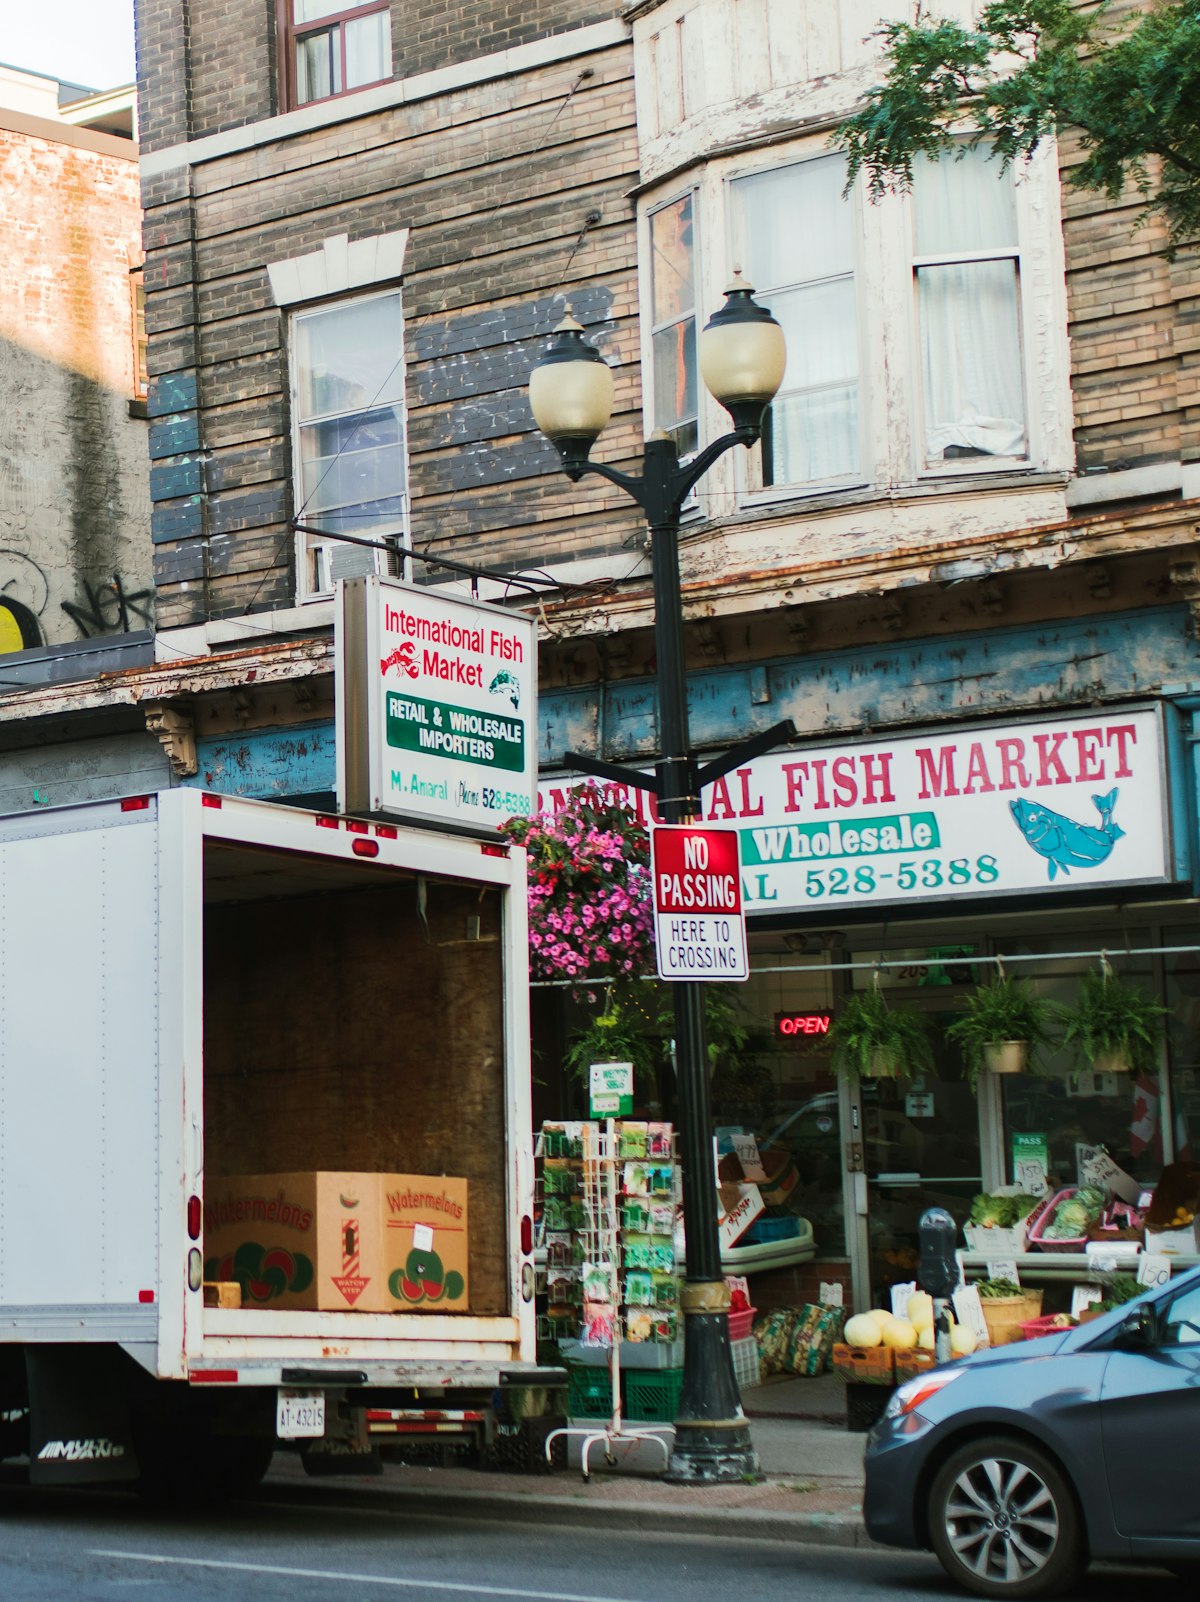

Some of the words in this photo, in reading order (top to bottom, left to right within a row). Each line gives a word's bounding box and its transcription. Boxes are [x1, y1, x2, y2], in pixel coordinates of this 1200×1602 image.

[385, 603, 484, 654] International
[490, 630, 523, 663] Fish
[423, 649, 483, 688] Market
[389, 697, 429, 725] RETAIL
[433, 706, 443, 727] &
[449, 711, 522, 744] WHOLESALE
[419, 728, 495, 761] IMPORTERS
[782, 752, 896, 814] FISH
[915, 724, 1137, 799] MARKET
[391, 769, 408, 793] M.
[410, 774, 448, 801] Amaral
[483, 787, 531, 815] 528-5388
[684, 836, 709, 871] NO
[752, 815, 933, 861] Wholesale
[661, 873, 736, 909] PASSING
[805, 853, 1000, 898] 528-5388
[671, 919, 707, 942] HERE
[713, 920, 731, 943] TO
[669, 946, 737, 970] CROSSING
[779, 1016, 830, 1034] OPEN
[1018, 1137, 1042, 1145] PASS
[203, 1188, 314, 1234] Watermelons
[386, 1186, 463, 1219] Watermelons
[337, 1279, 365, 1287] WATCH
[1141, 1263, 1168, 1285] 150
